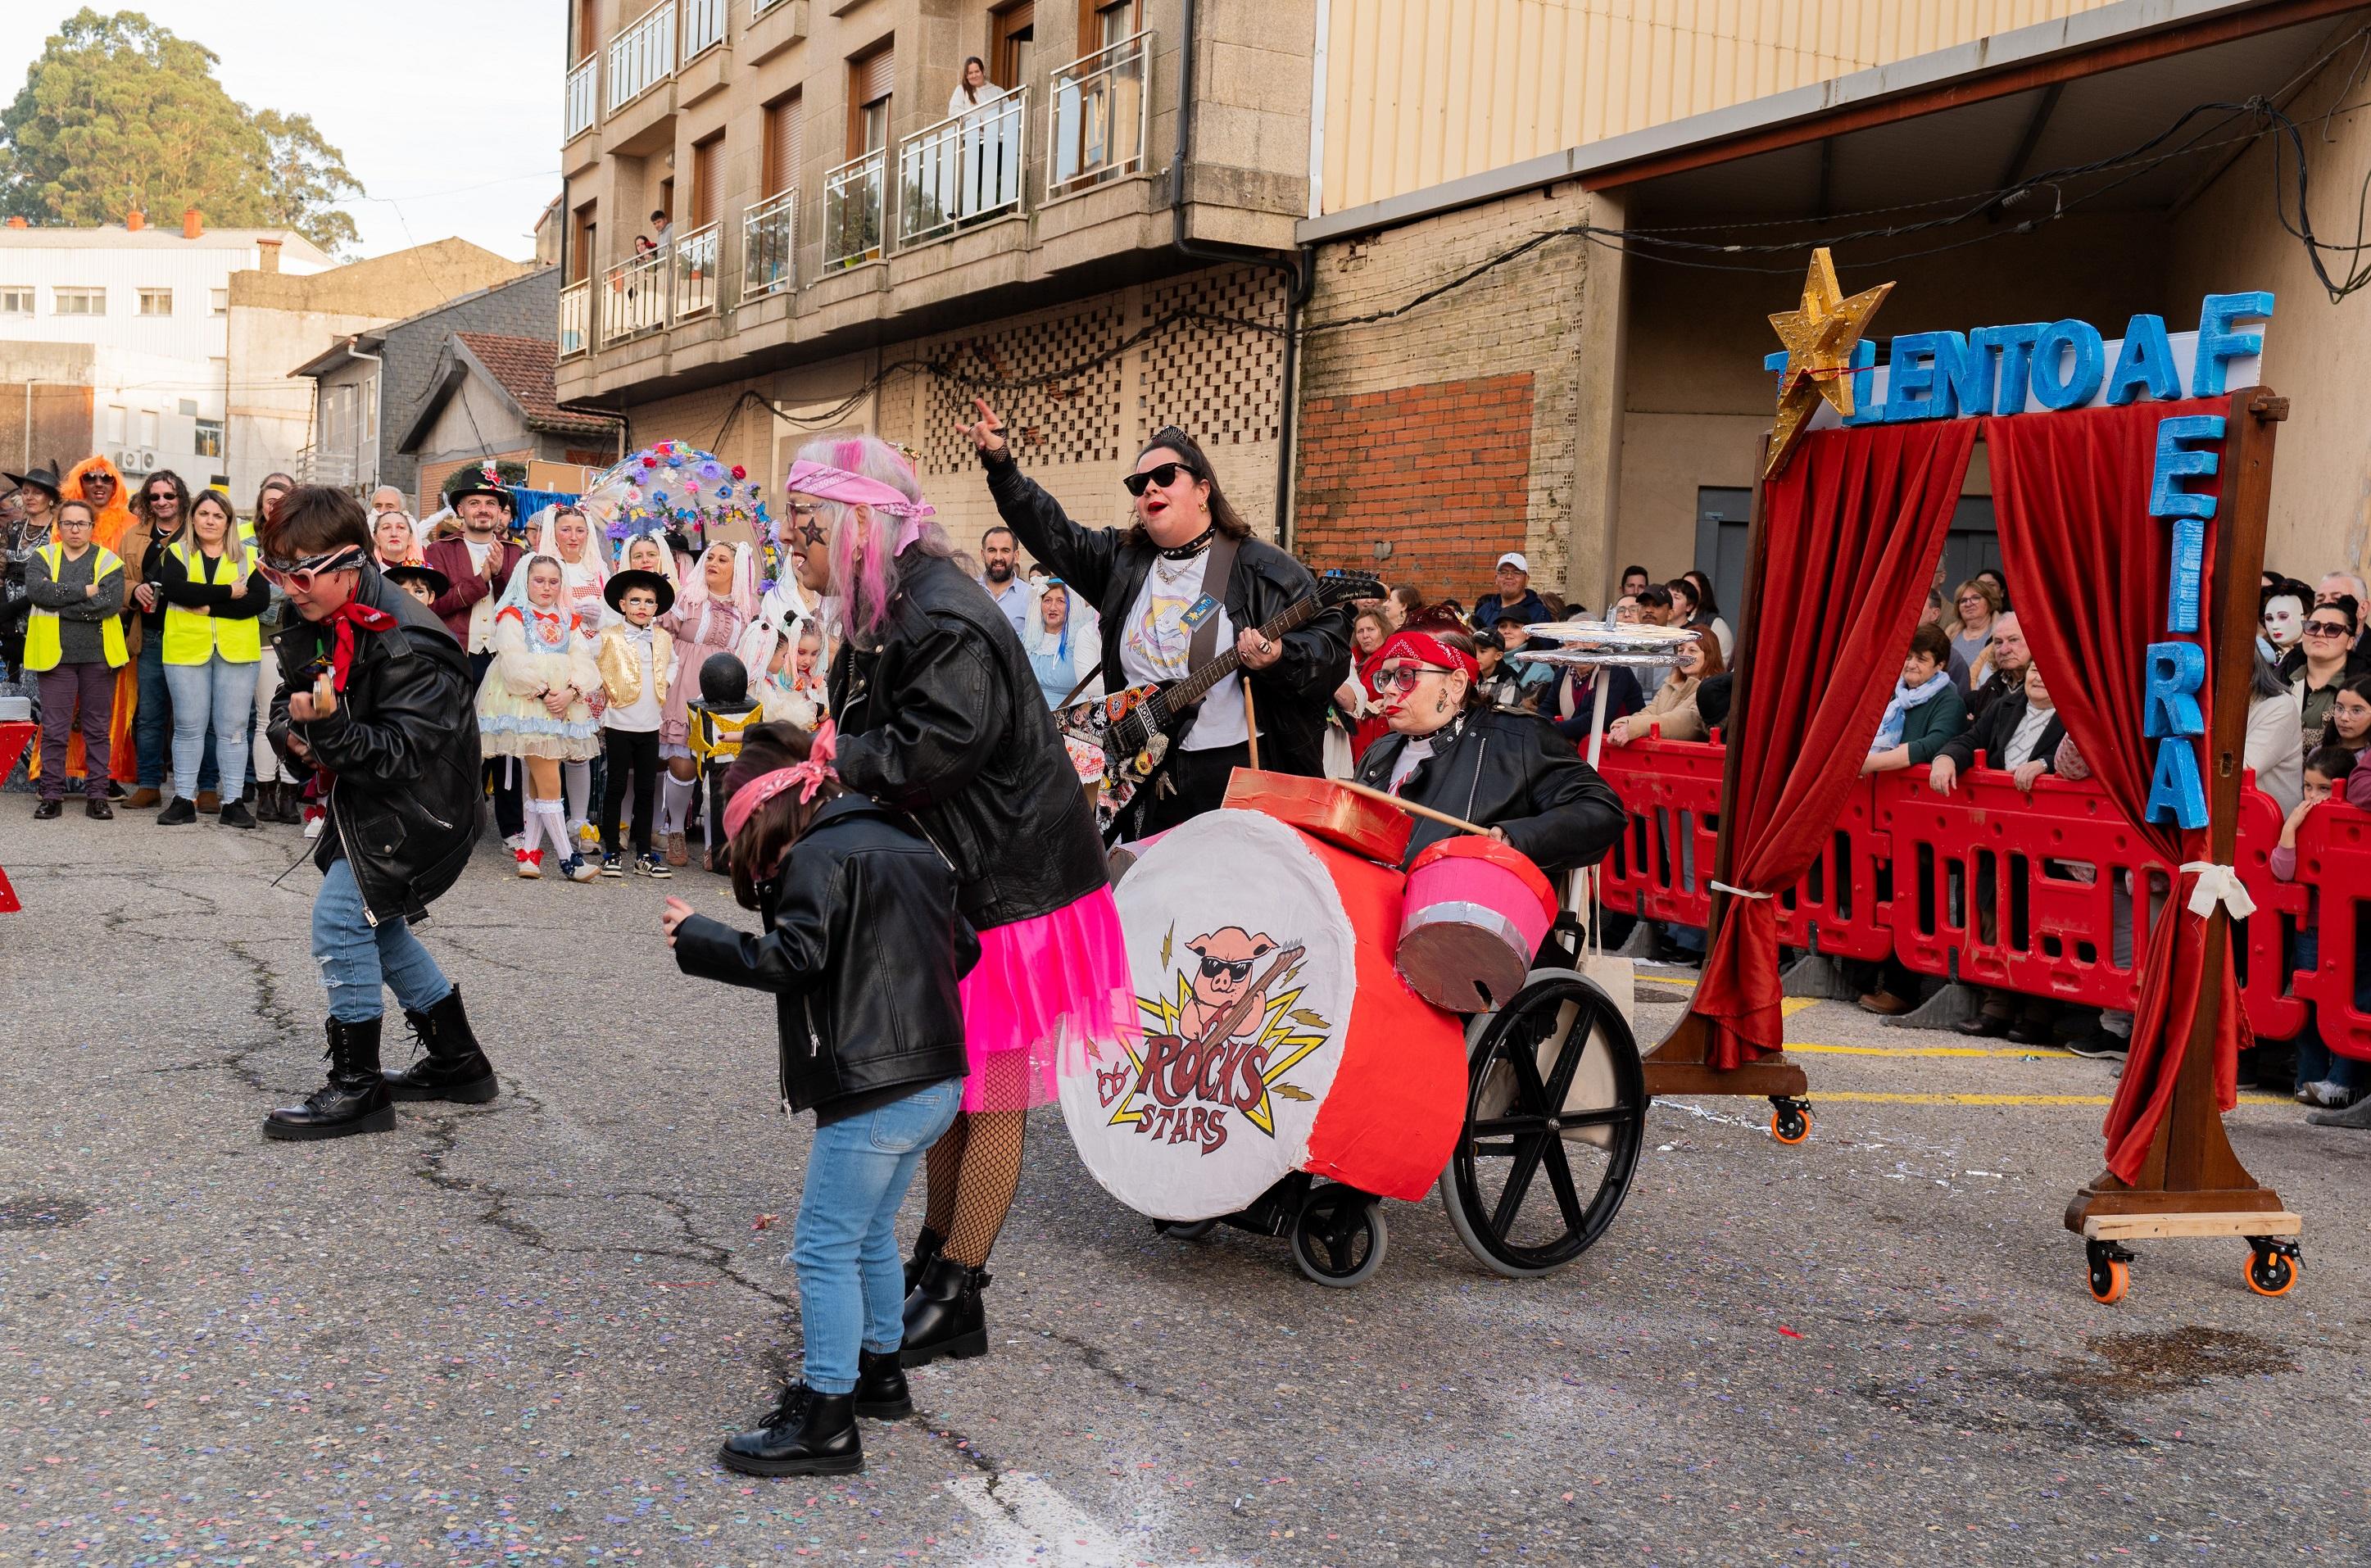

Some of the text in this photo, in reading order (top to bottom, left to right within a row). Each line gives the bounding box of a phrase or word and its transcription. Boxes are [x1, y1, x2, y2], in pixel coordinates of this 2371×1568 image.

[1764, 319, 2104, 427] LENTO
[1136, 1035, 1271, 1112] ROCKS
[1135, 1103, 1227, 1158] STARS
